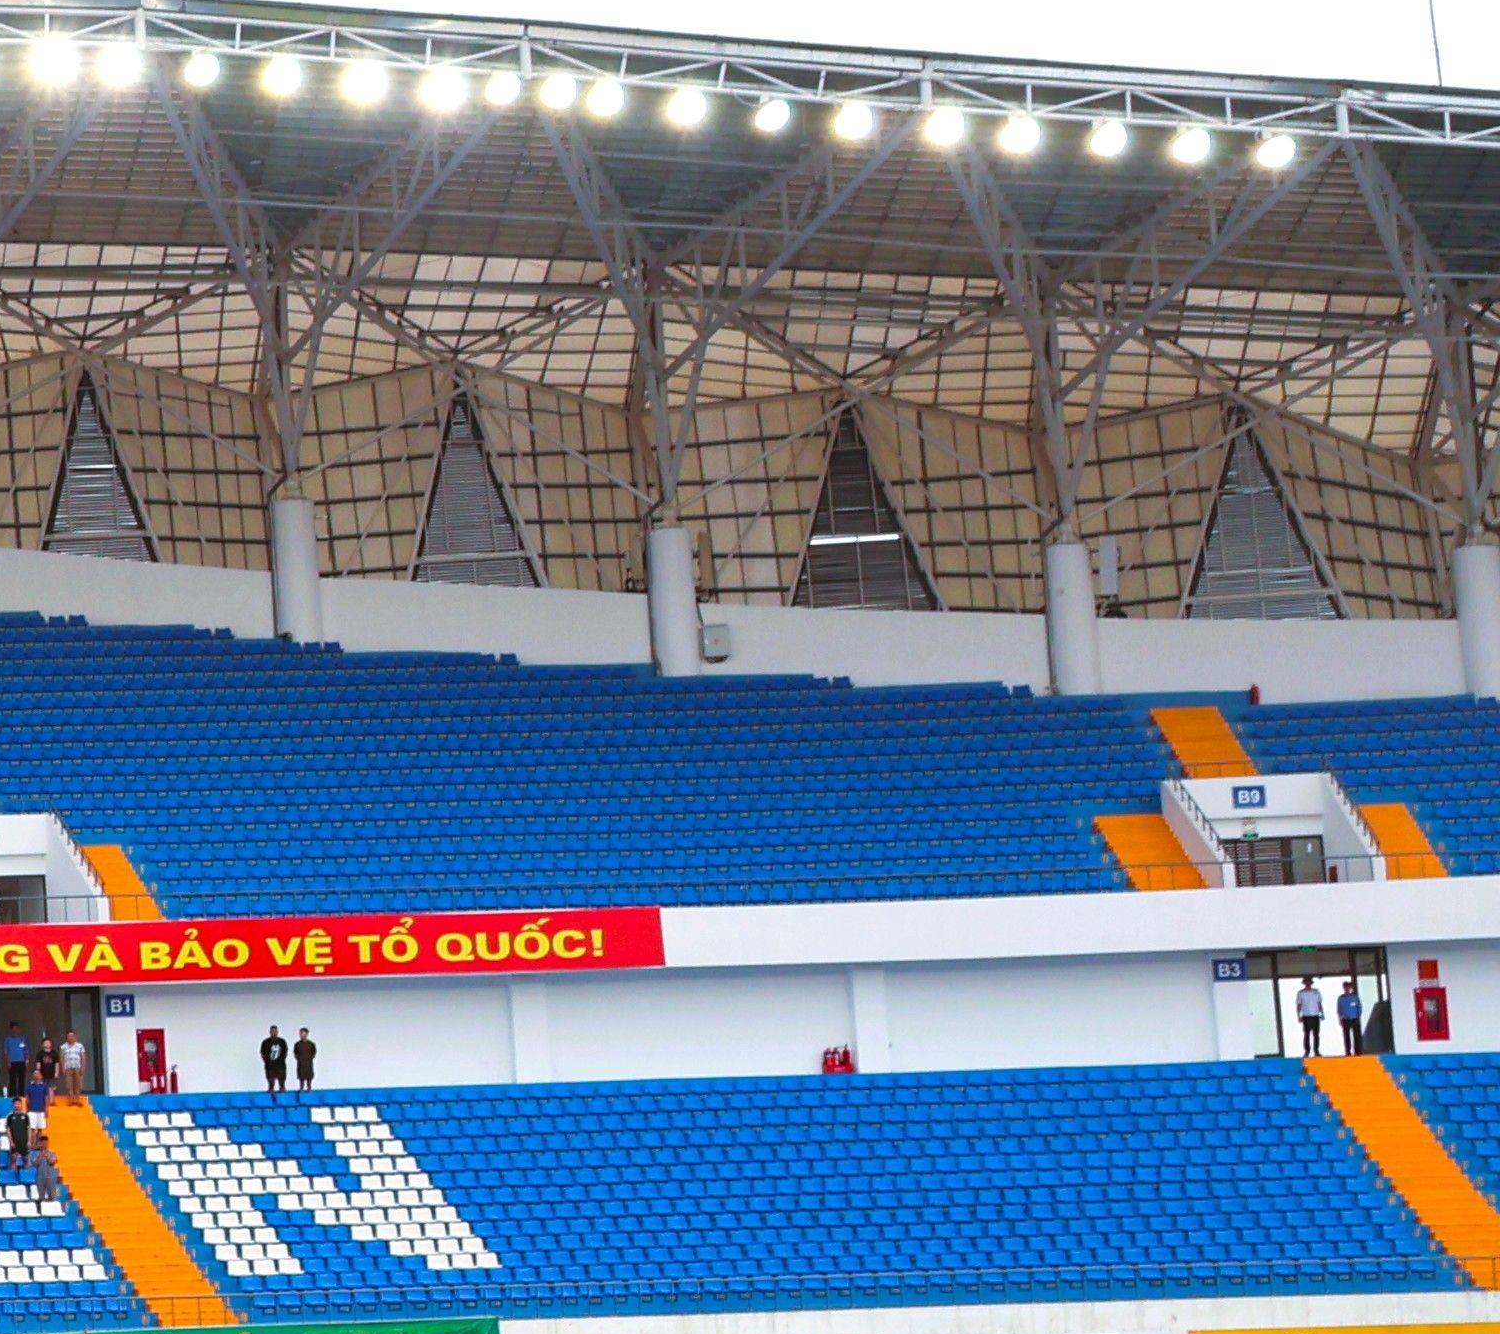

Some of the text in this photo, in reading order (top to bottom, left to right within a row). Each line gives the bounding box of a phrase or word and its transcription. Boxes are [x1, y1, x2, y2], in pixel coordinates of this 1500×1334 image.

[1238, 790, 1260, 803] B9
[47, 937, 122, 971] VÀ
[141, 929, 249, 969] BẢO
[267, 930, 332, 972] VỆ
[349, 917, 418, 962] TỔ
[437, 919, 602, 961] QUỐC!
[1219, 963, 1240, 977] B3
[111, 999, 130, 1012] B1
